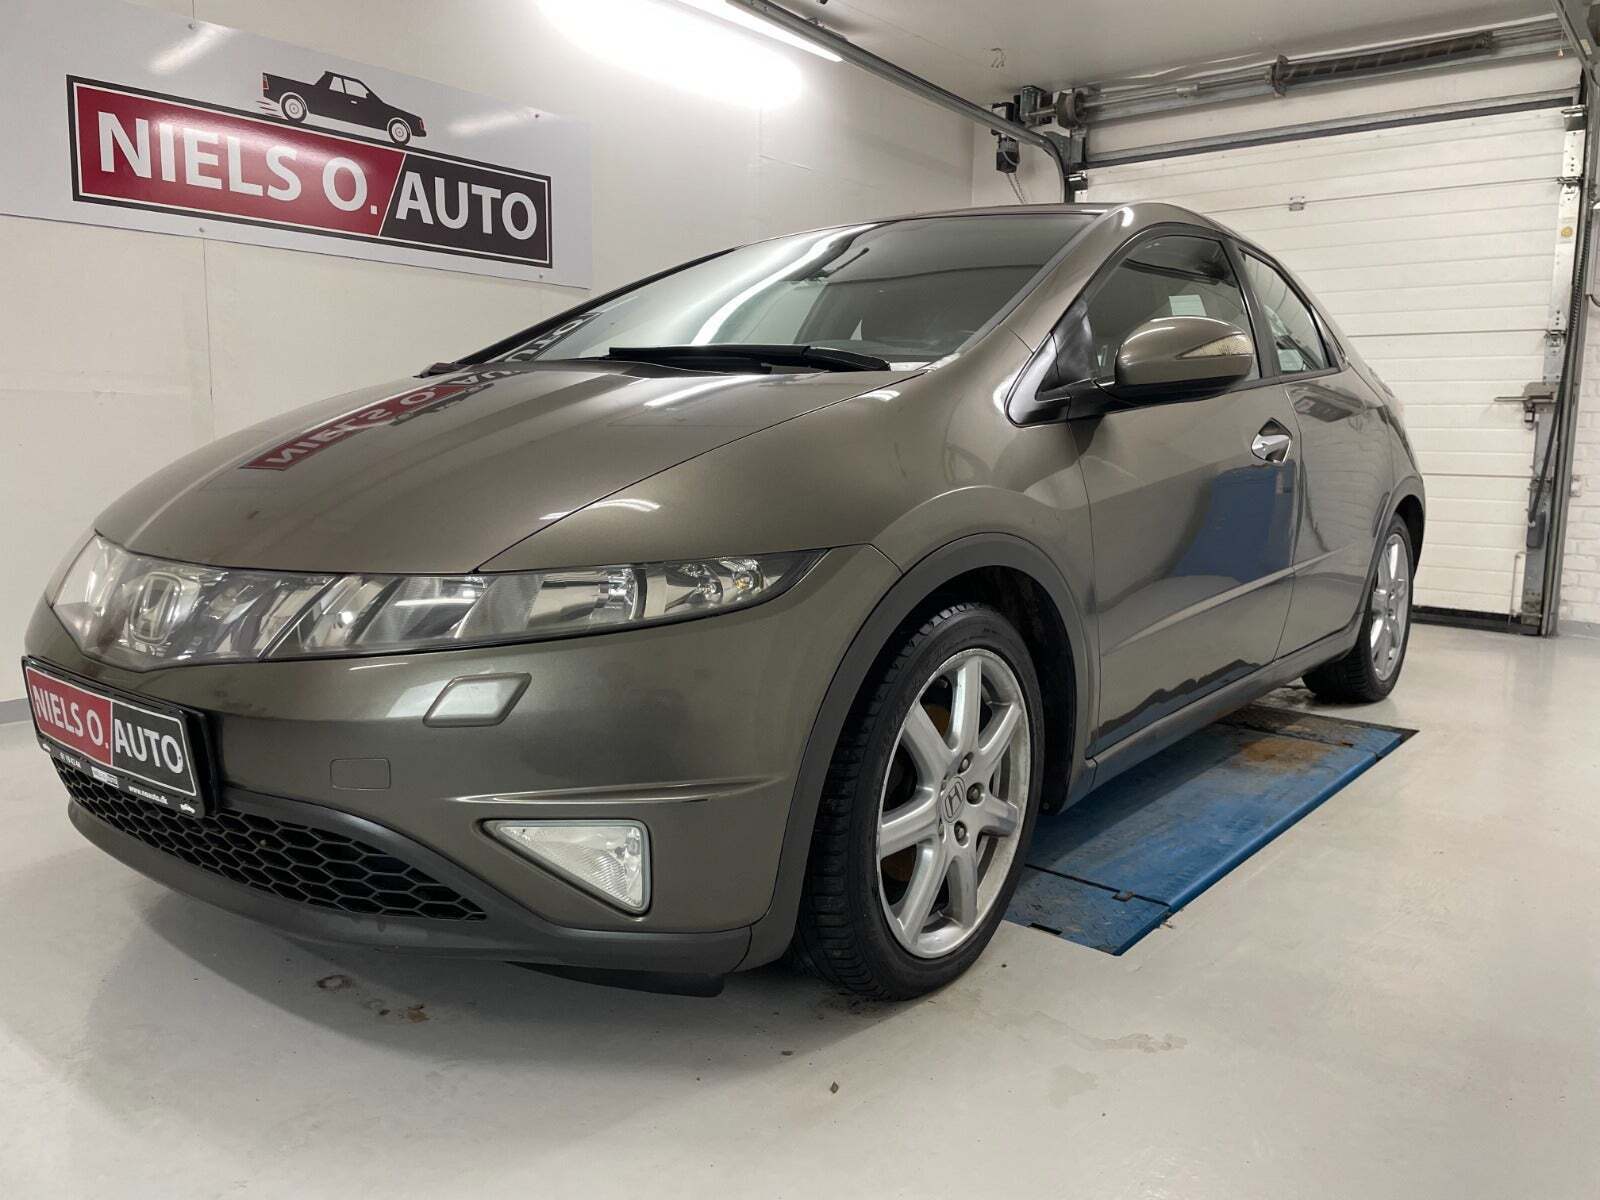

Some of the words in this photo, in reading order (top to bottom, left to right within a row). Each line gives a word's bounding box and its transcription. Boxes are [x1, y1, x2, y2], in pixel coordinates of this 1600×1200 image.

[98, 112, 301, 201] NIELS
[322, 157, 378, 215] O.
[396, 171, 537, 240] AUTO
[32, 685, 83, 738] NIELS
[86, 709, 110, 749] O.
[114, 718, 184, 774] AUTO
